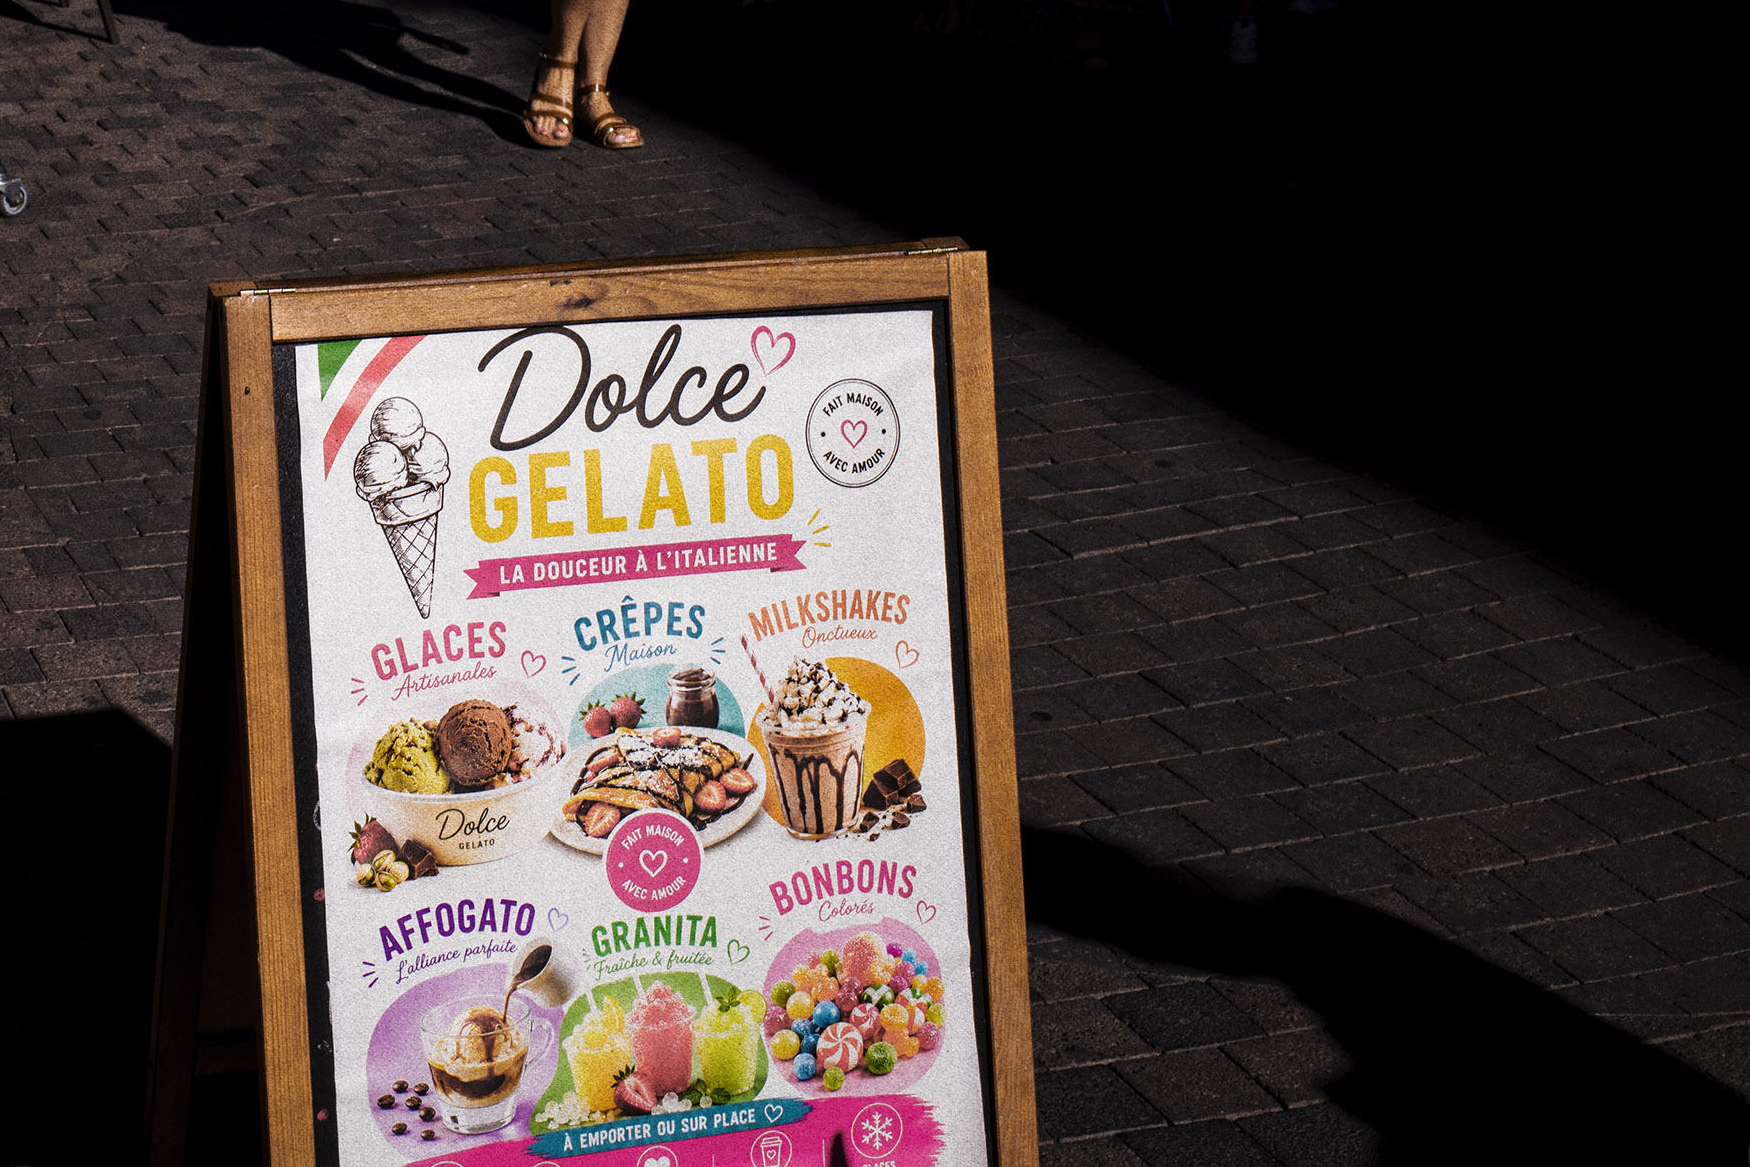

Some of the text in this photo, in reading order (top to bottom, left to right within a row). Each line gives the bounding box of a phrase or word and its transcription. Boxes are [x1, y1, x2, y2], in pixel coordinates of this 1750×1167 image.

[477, 323, 766, 452] Dolce
[822, 393, 885, 417] FAIT MAISON
[822, 447, 887, 474] AVEC AMOUR
[468, 434, 795, 543] GELATO
[499, 542, 778, 585] LA DOUCEUR À L'ITALIENNE
[573, 595, 706, 651] CRÊPES
[747, 589, 911, 641] MILKSHAKES
[371, 621, 507, 681] GLACES
[603, 641, 677, 672] Maison
[801, 625, 879, 650] Onctueux
[391, 661, 497, 701] Artisanales
[435, 808, 511, 841] Dolce
[458, 838, 495, 850] GELATO
[621, 826, 685, 851] FAIT MAISON
[621, 874, 687, 901] AVEC AMOUR
[768, 858, 917, 916] BONBONS
[379, 898, 536, 961] AFFOGATO
[818, 900, 876, 922] Colorés
[591, 915, 718, 958] GRANITA
[396, 939, 518, 984] L'alliance parfaite
[593, 948, 714, 981] Fraîche & fruitée
[563, 1108, 756, 1151] À EMPORTER OU SUR PLACE
